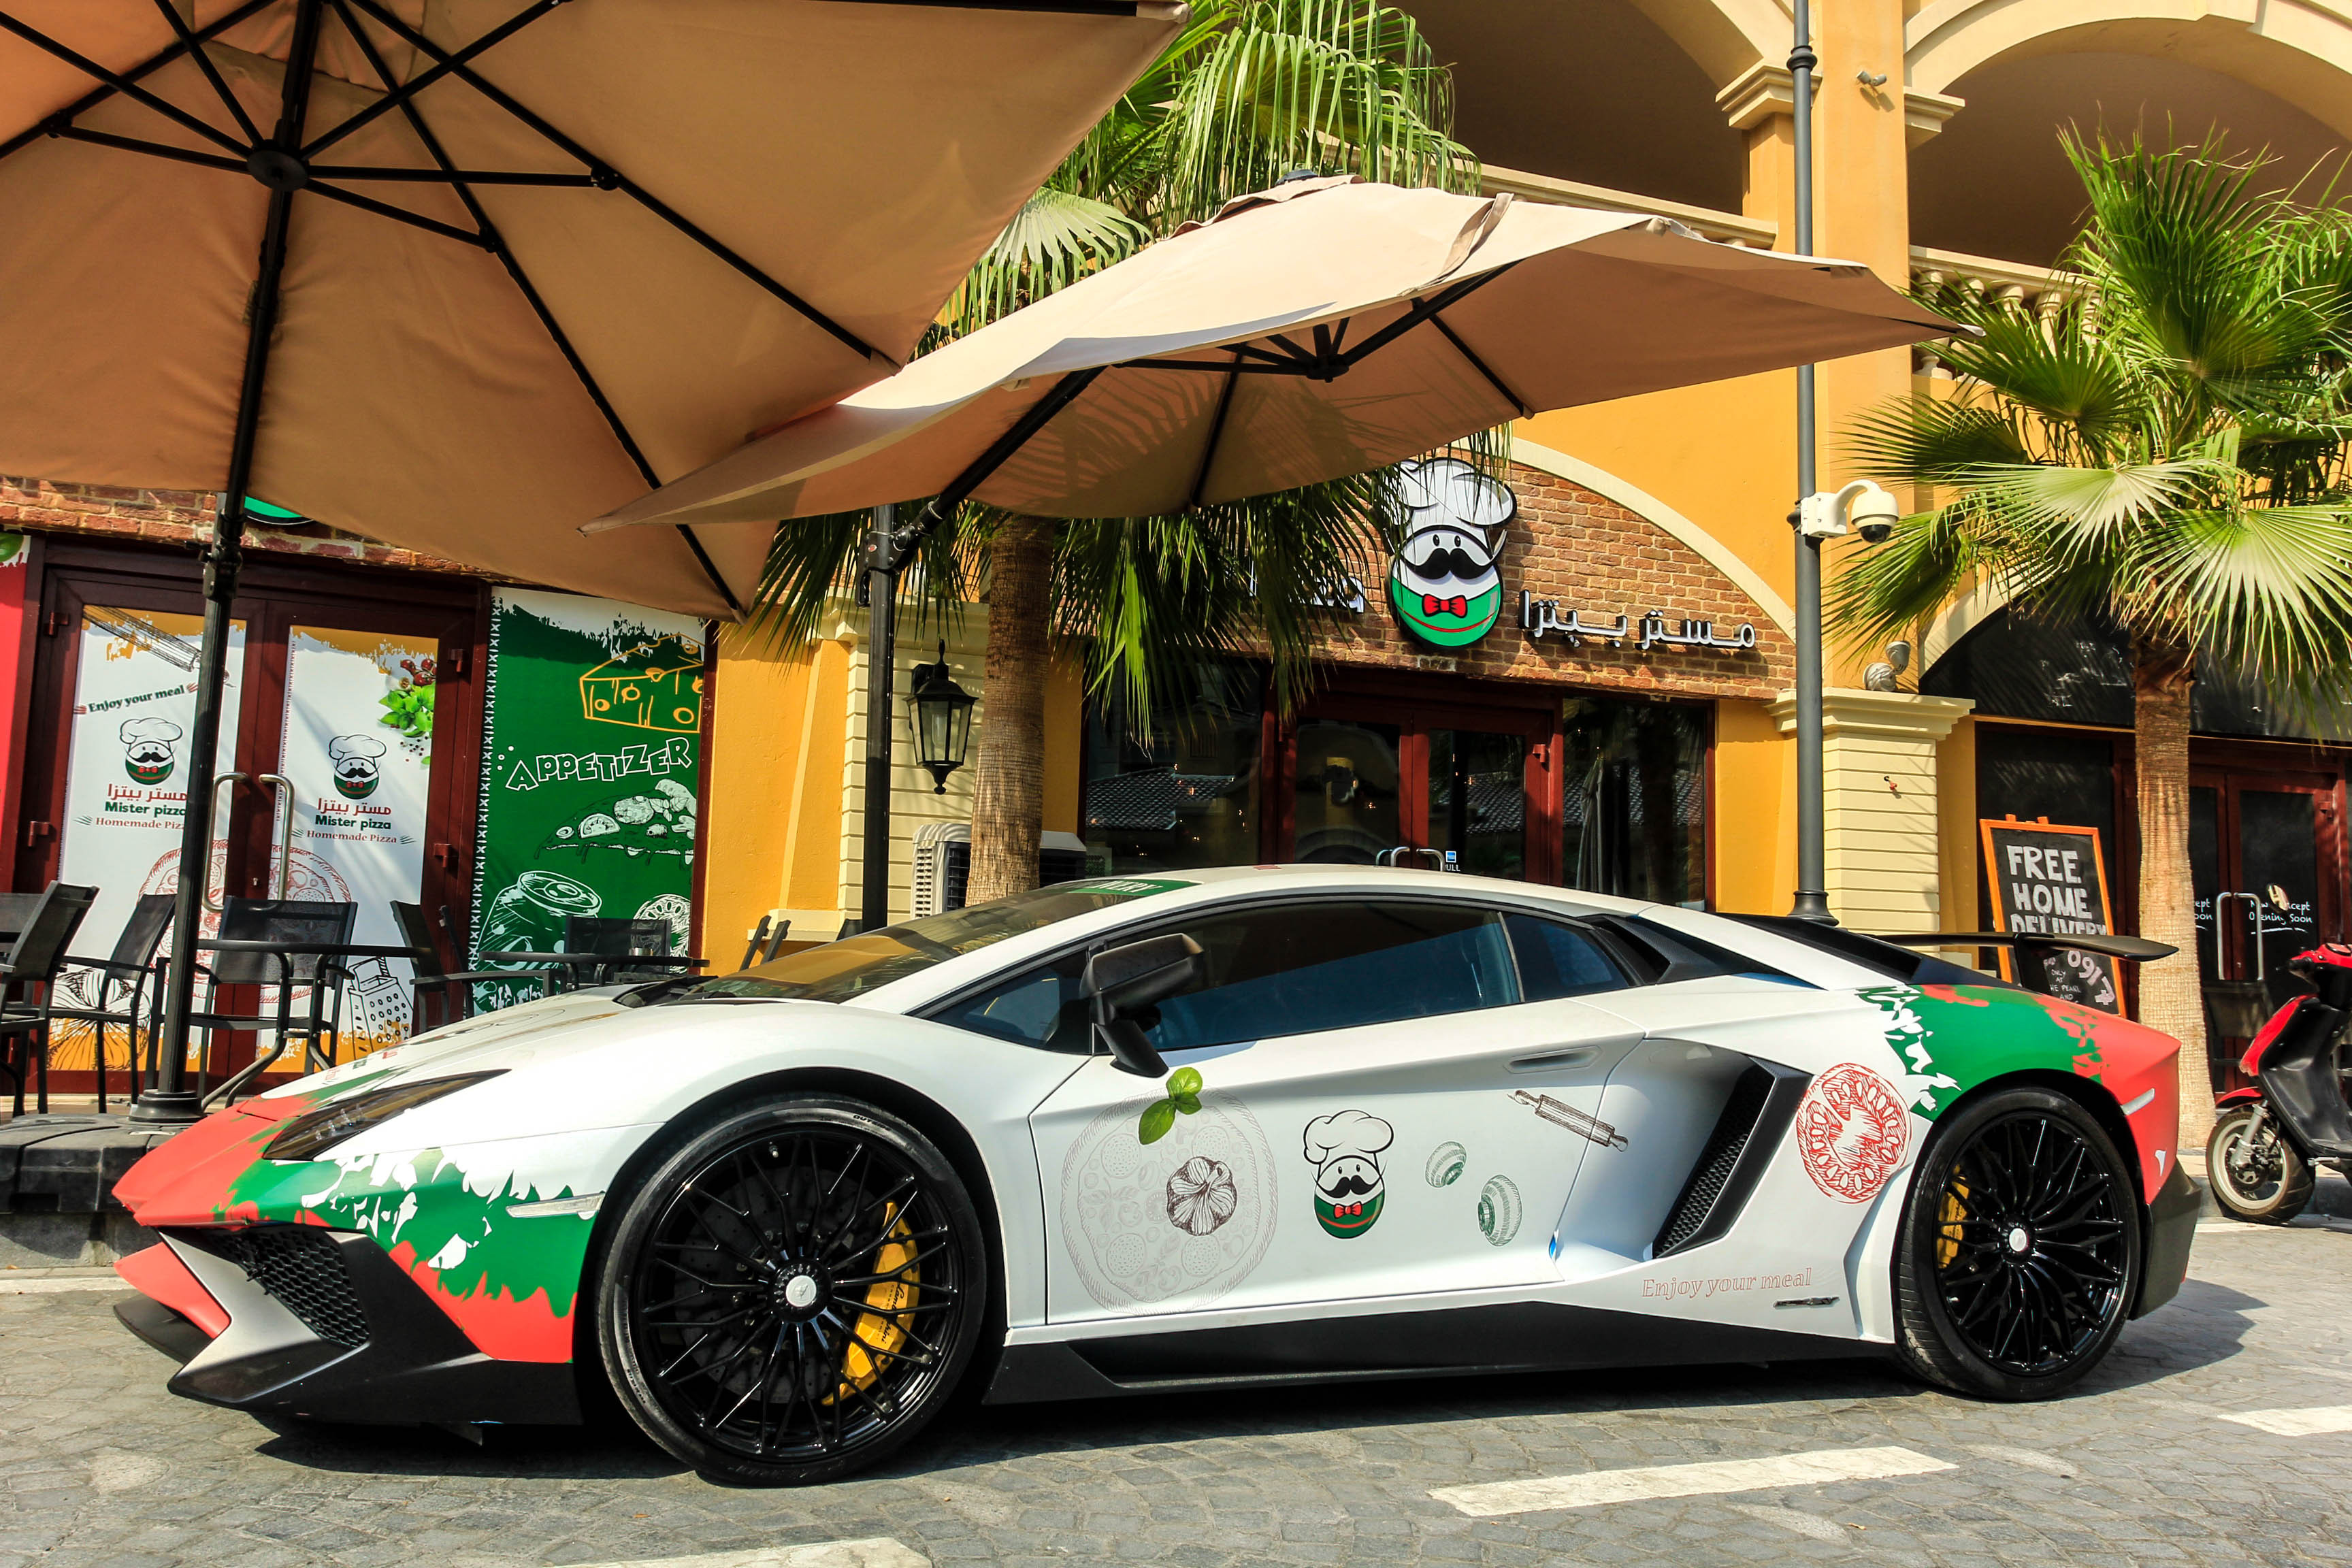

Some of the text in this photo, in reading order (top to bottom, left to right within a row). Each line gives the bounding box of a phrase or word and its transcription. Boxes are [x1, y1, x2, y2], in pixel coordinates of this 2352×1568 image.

[1519, 589, 1757, 651] مستر بيتزا
[88, 684, 184, 713] Enjoy your meal
[505, 737, 692, 791] APPETIZER
[107, 783, 142, 802] بيتزا
[105, 802, 150, 814] Mister
[317, 798, 392, 816] مستر بيتزا
[95, 817, 184, 830] Homemade Piz
[315, 815, 391, 831] Mister pizza
[307, 830, 397, 843] Homemade Pizza
[1445, 864, 1461, 872] ULL
[2006, 845, 2082, 883] FREE
[2012, 882, 2092, 919] HOME
[2249, 911, 2313, 926] Oening Soon
[1642, 1267, 1812, 1301] Enjoy your meal
